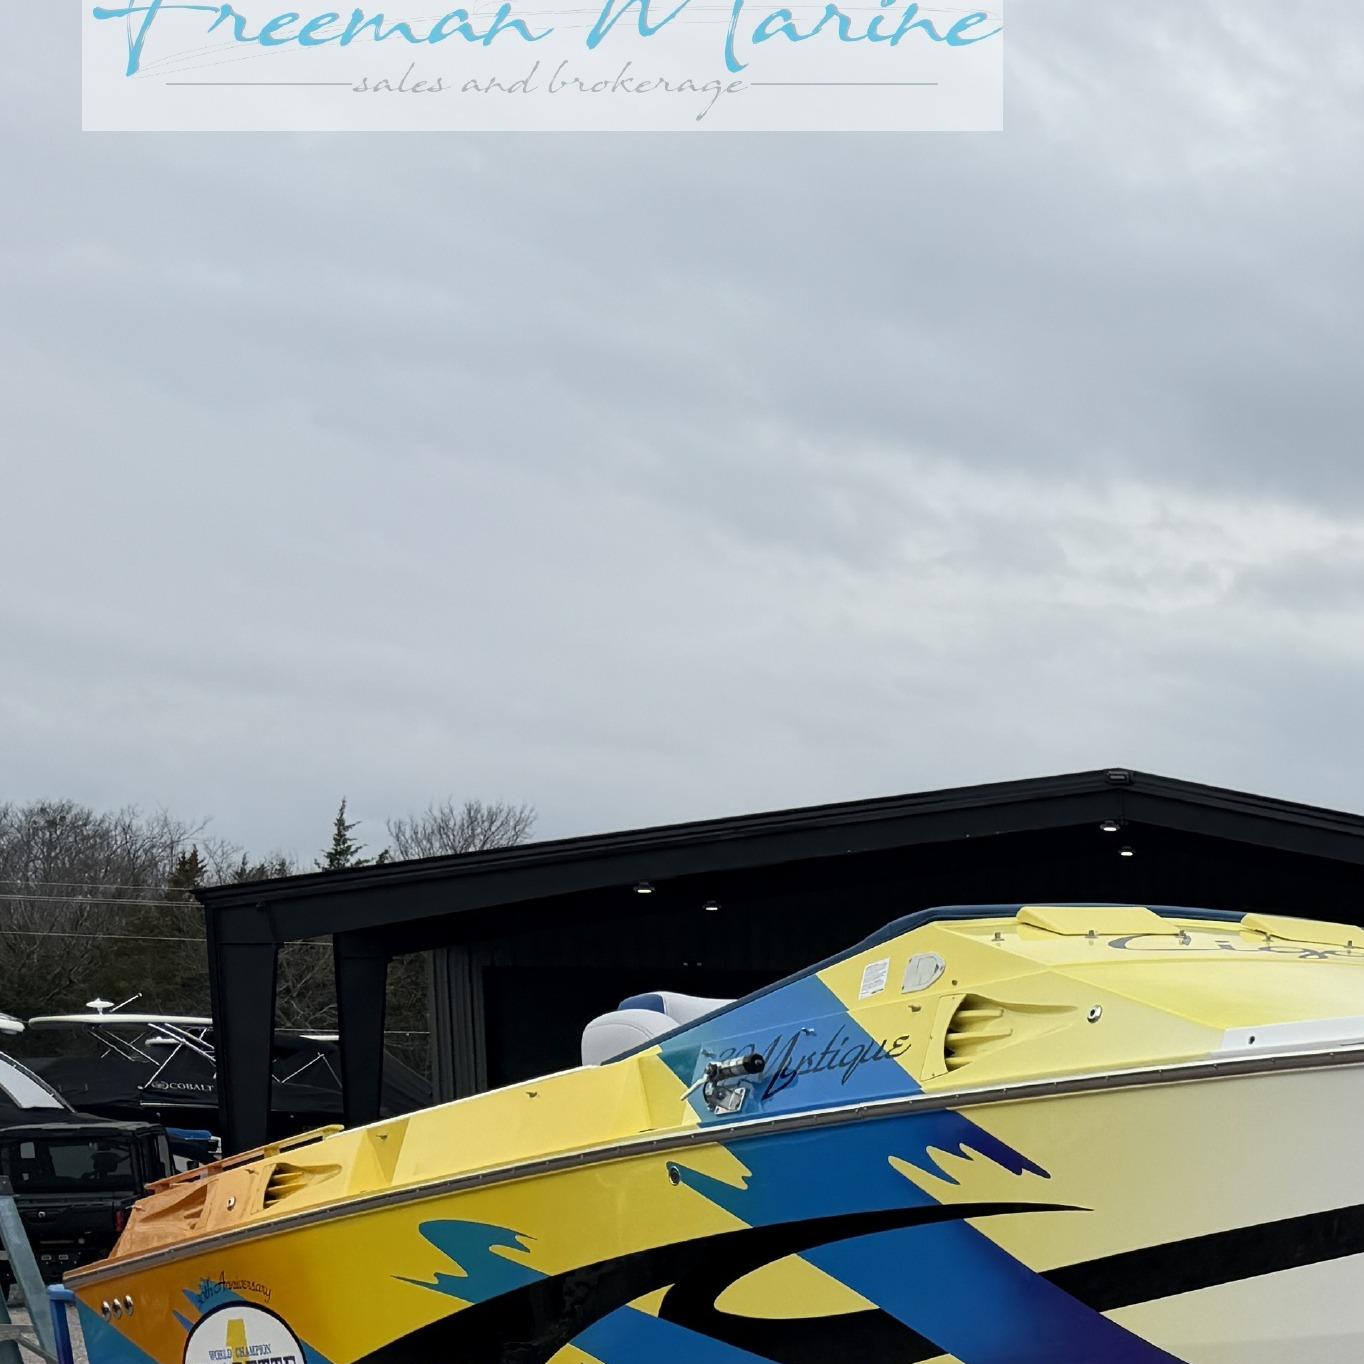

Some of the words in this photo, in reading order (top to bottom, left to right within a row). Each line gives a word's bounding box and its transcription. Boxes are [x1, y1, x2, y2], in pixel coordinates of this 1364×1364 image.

[761, 1023, 912, 1101] Mystique
[169, 1082, 213, 1091] COBALT
[208, 1348, 233, 1360] WORLD
[235, 1344, 272, 1358] CHAMPION
